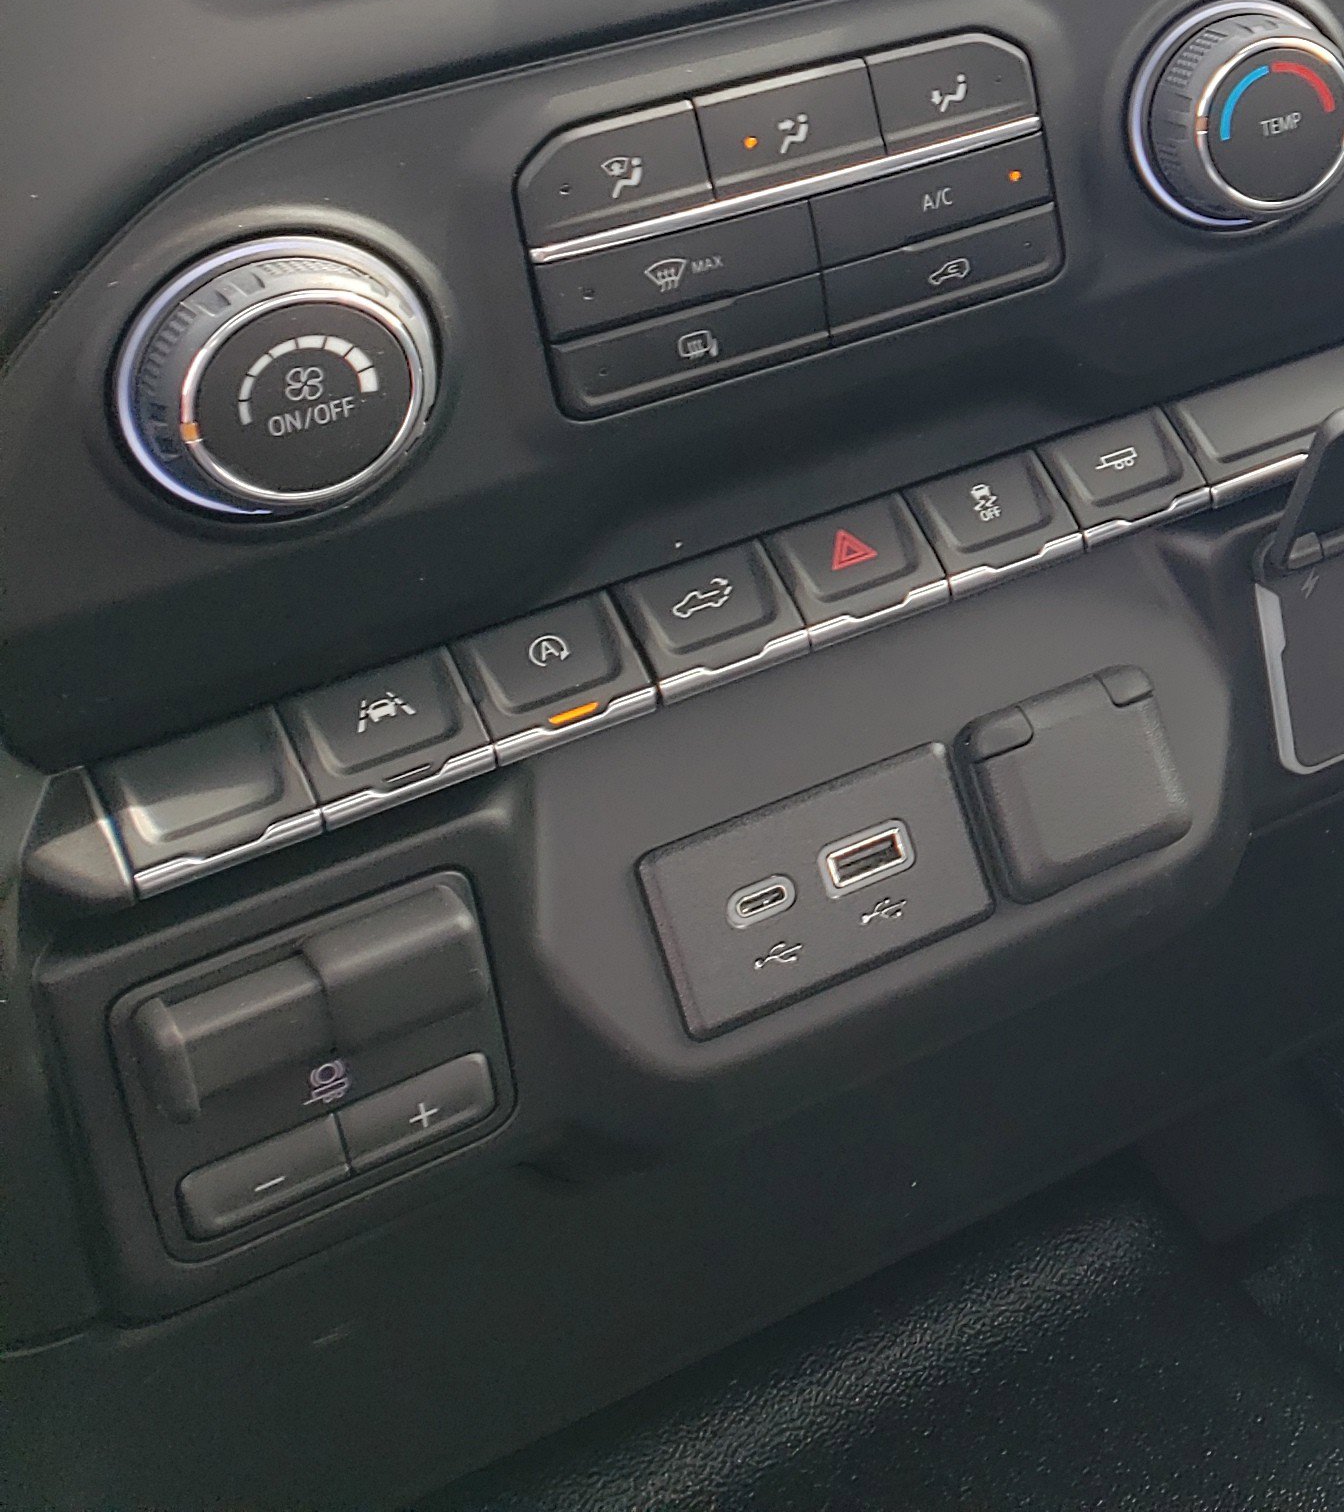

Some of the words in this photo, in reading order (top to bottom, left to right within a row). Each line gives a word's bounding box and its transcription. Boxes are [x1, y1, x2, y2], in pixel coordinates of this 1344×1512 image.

[1258, 112, 1302, 137] TEMP
[922, 188, 953, 213] A/C
[690, 255, 724, 275] MAX
[268, 396, 355, 437] ON/OFF
